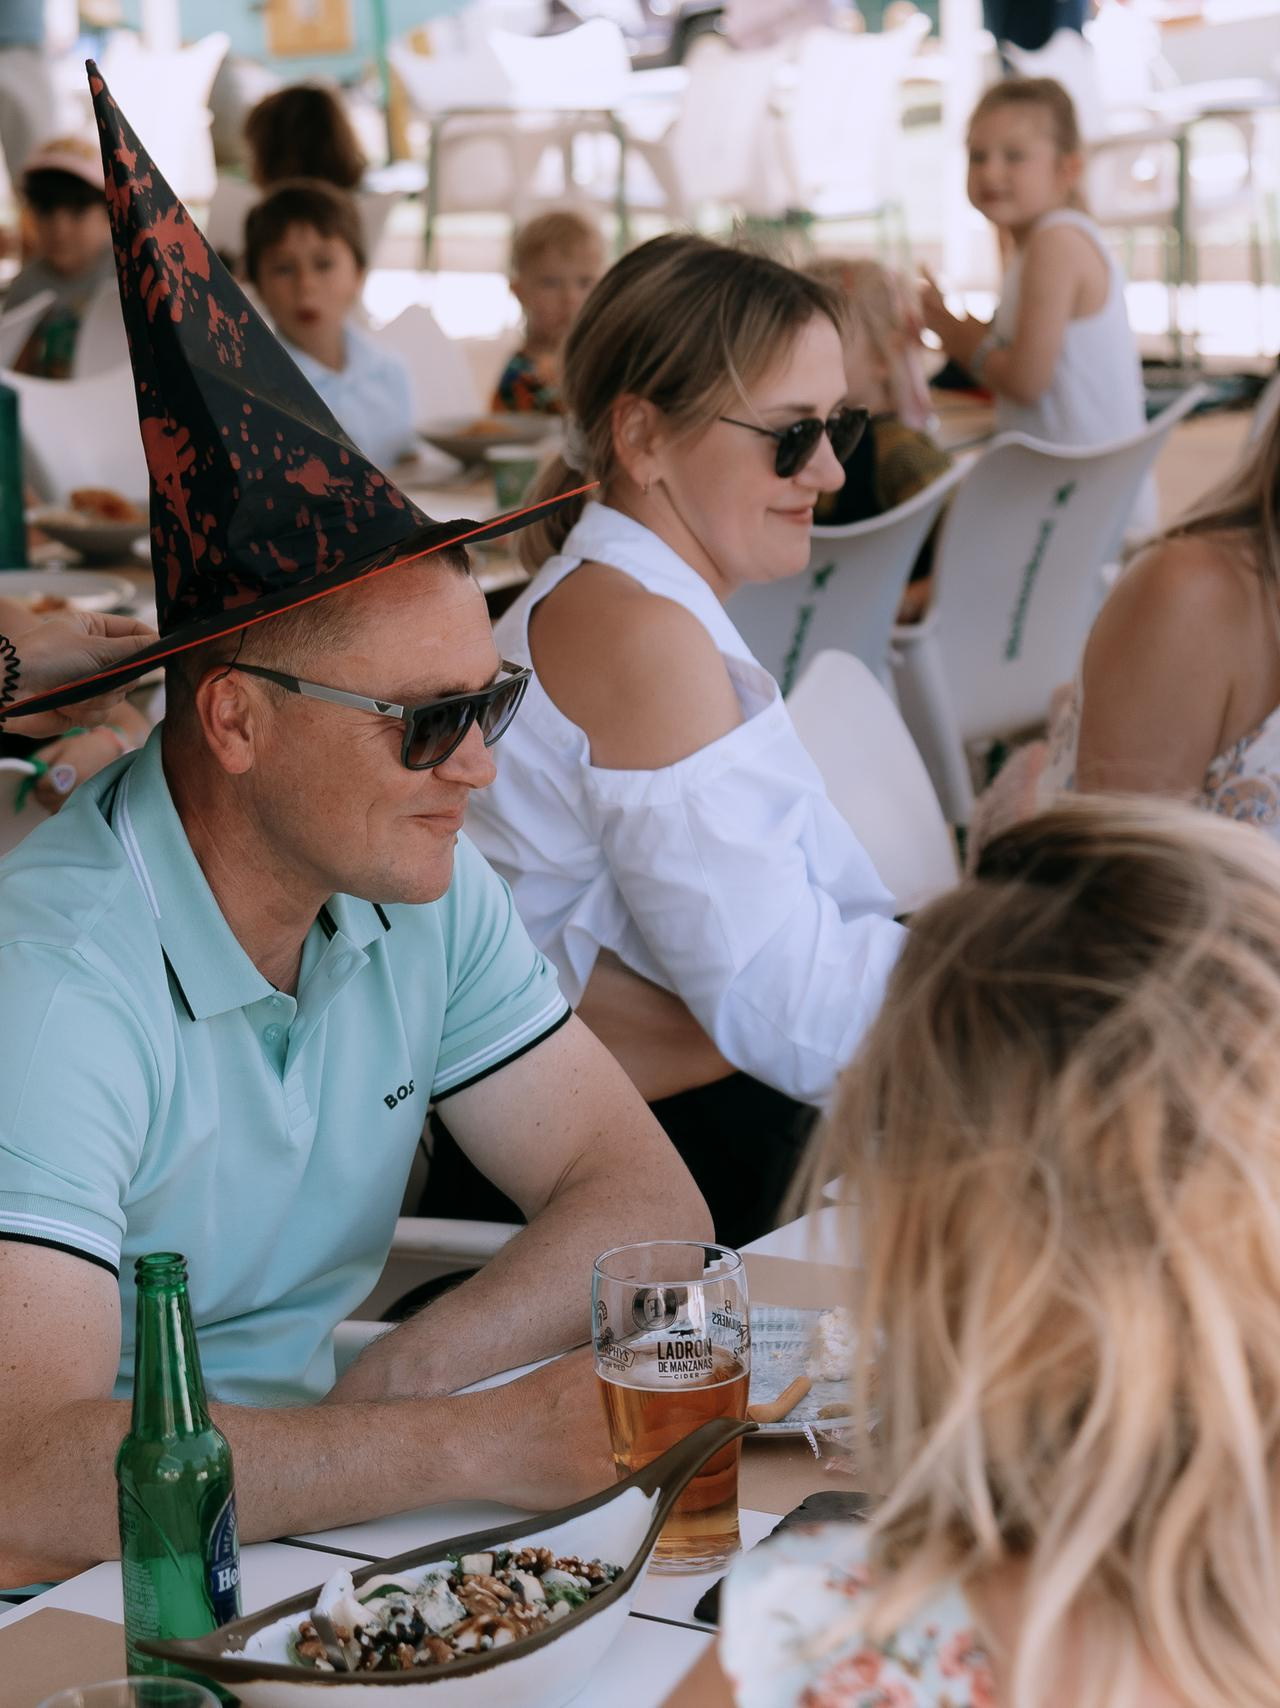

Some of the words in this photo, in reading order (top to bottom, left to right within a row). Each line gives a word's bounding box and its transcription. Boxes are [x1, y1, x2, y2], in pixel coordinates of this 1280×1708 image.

[383, 1079, 415, 1110] BOS
[658, 1361, 669, 1373] DE
[669, 1358, 713, 1373] MANZANAS
[673, 1372, 700, 1380] CIDER
